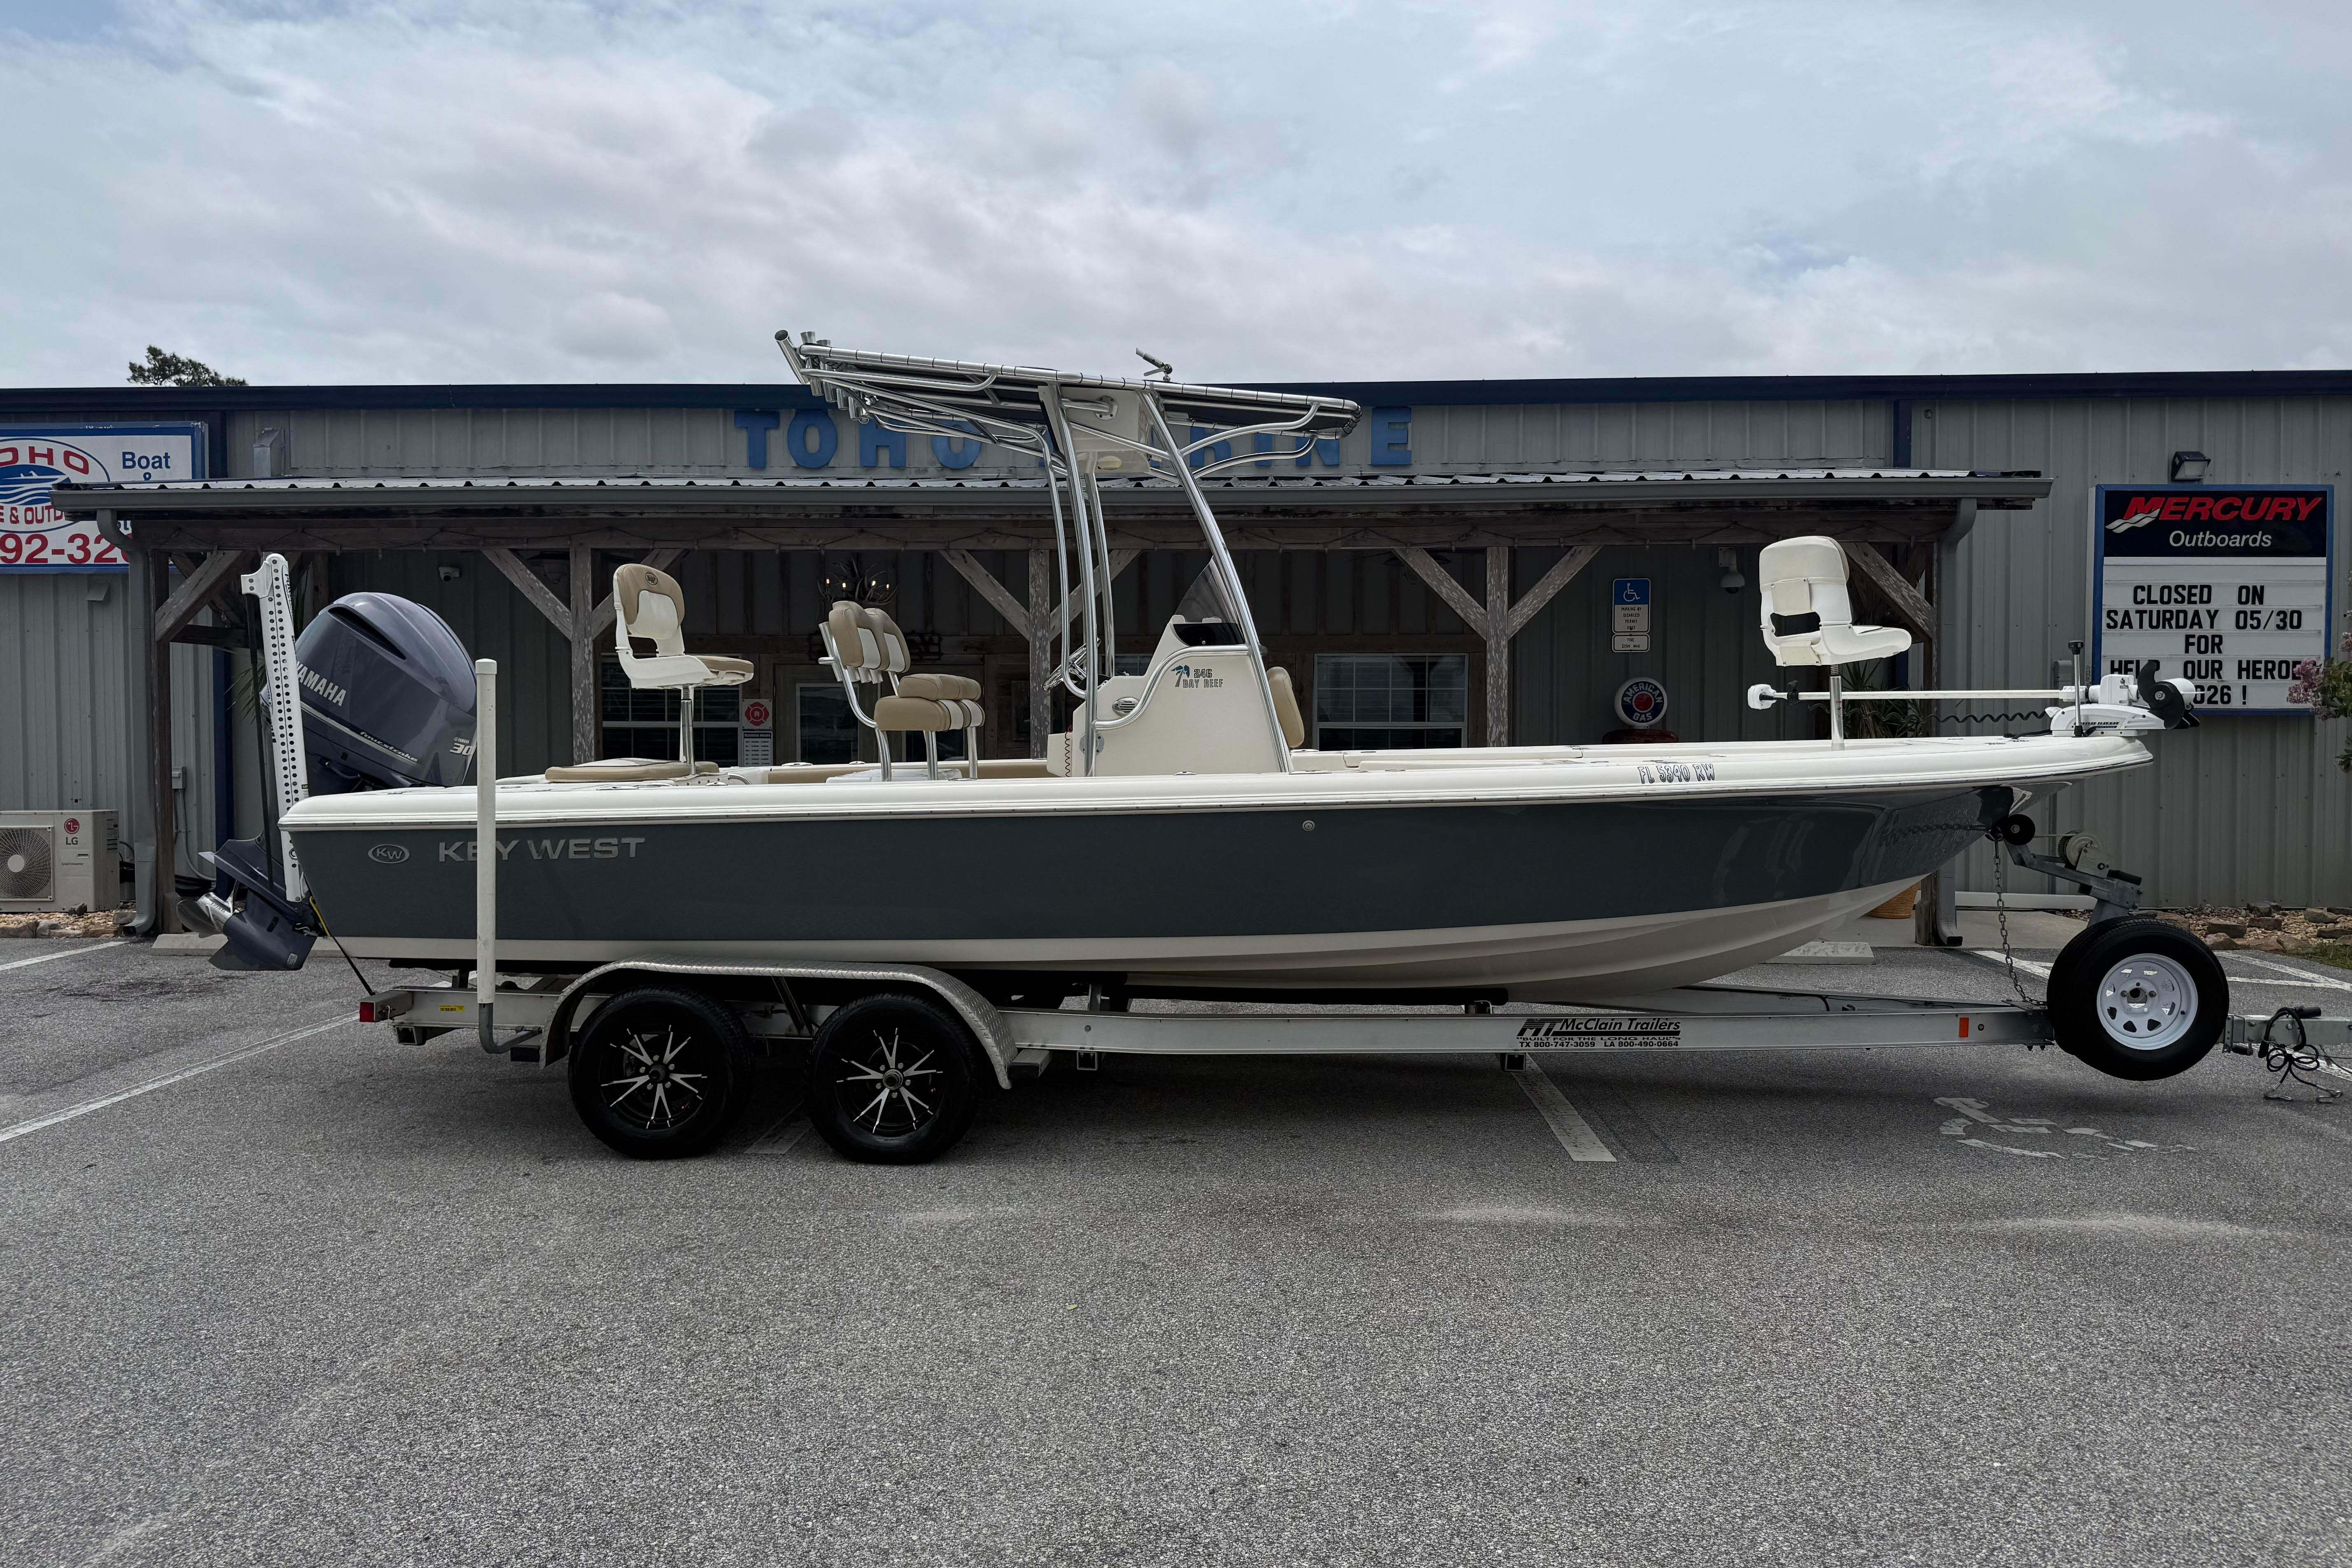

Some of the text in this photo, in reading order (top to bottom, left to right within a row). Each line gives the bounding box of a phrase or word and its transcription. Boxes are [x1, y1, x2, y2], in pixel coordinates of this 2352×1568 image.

[734, 409, 981, 469] TOHO
[122, 451, 170, 469] Boat
[2123, 497, 2322, 520] MERCURY
[0, 533, 130, 564] 92-32
[2169, 531, 2272, 547] Outboards
[2133, 585, 2264, 605] CLOSED ON
[2106, 609, 2302, 630] SATURDAY 05/30
[2184, 634, 2223, 654] FOR
[1194, 669, 1212, 678] 246
[2183, 660, 2223, 680] OUR
[2238, 660, 2317, 680] HEROE
[296, 661, 347, 707] YAMAHA
[1183, 679, 1223, 688] BAY REEF
[1623, 682, 1663, 705] AMERICAN
[2193, 685, 2247, 705] 026 !
[1632, 712, 1653, 721] GAS
[1637, 763, 1715, 784] FL 5340 RW
[66, 837, 78, 845] LG
[527, 838, 645, 860] WEST
[376, 846, 402, 860] KW
[1559, 1017, 1681, 1030] McClain Trailers
